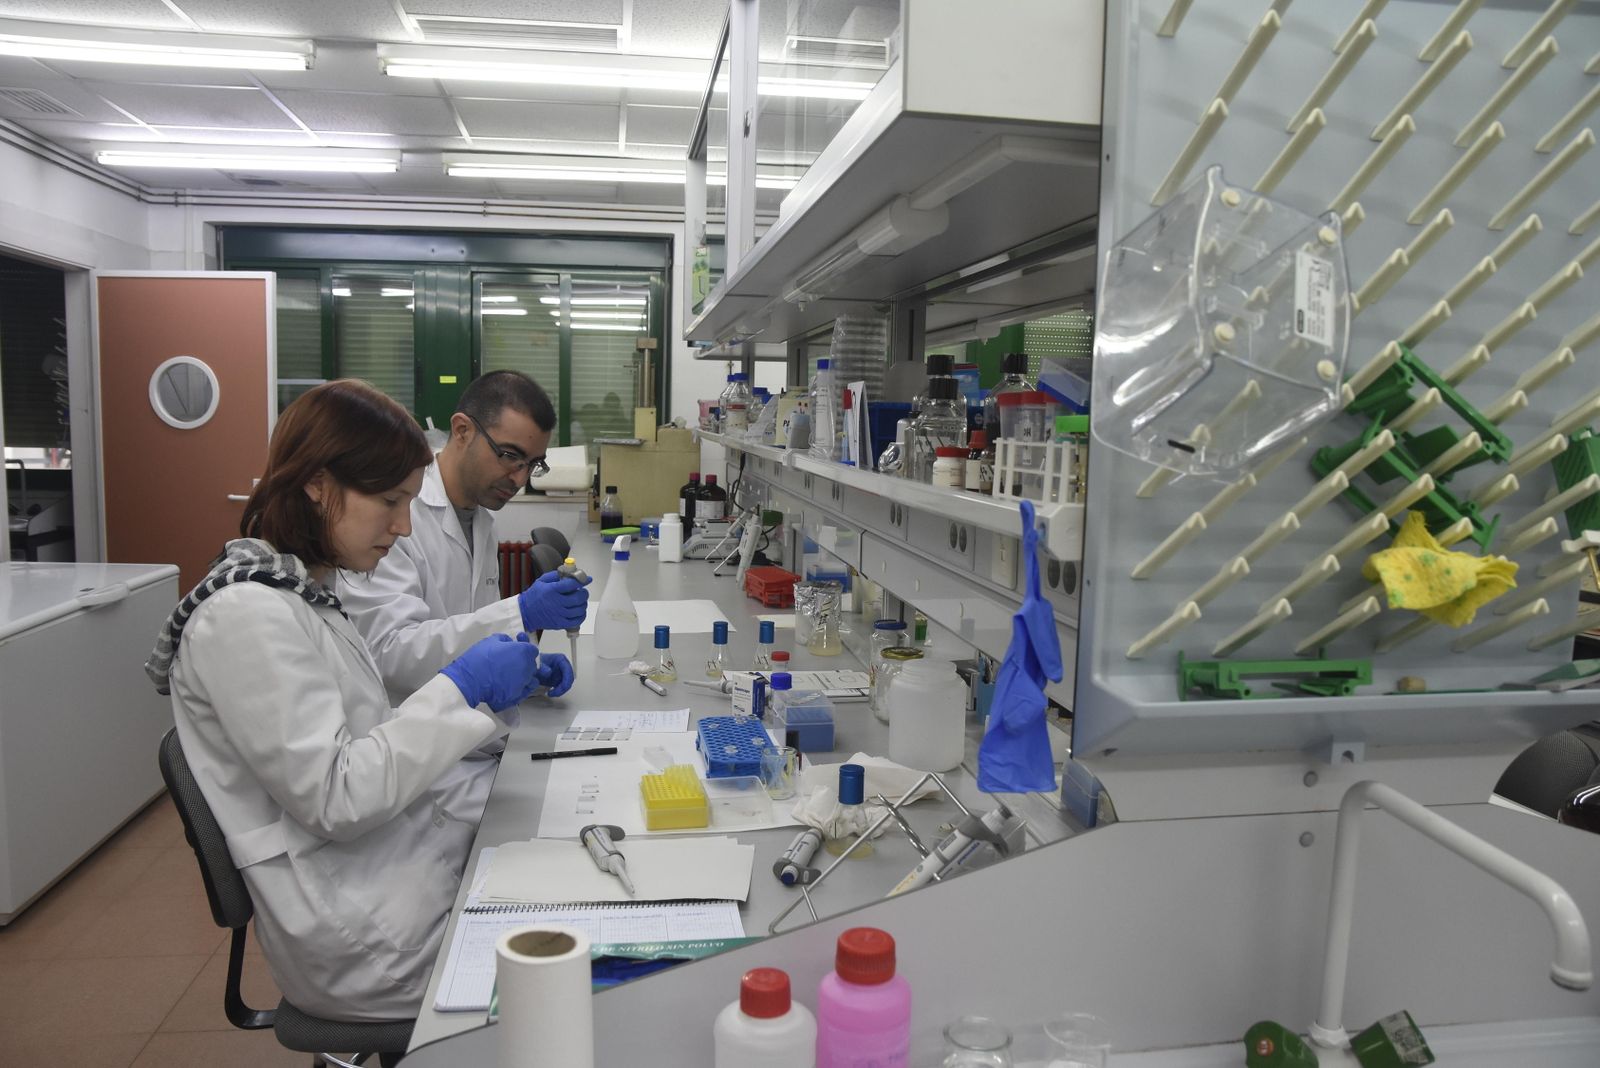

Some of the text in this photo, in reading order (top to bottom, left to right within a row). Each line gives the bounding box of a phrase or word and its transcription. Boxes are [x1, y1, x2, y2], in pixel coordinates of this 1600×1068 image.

[620, 945, 664, 953] NITRILO
[666, 943, 684, 951] SIN
[688, 941, 724, 949] POLVO
